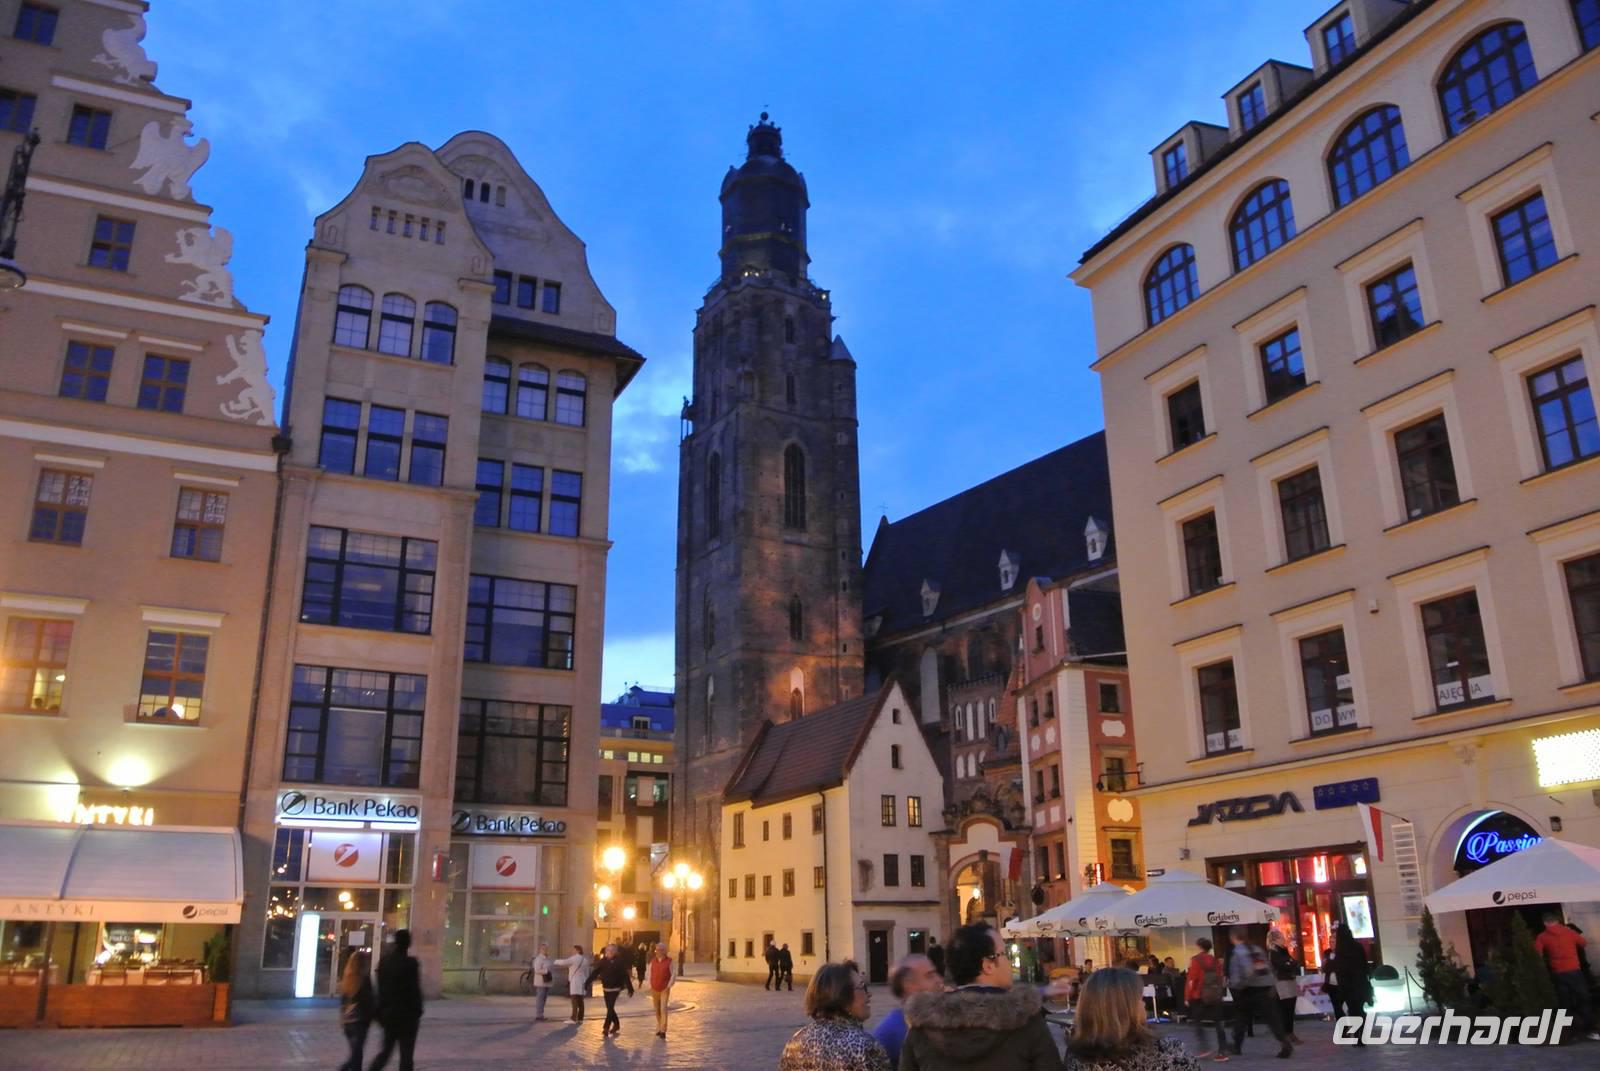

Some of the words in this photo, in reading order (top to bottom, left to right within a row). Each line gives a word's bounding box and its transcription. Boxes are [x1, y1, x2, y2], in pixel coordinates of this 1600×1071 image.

[313, 797, 360, 815] Bank
[363, 799, 419, 818] Pekao
[476, 814, 516, 832] Bank
[519, 816, 567, 833] Pekao
[1507, 889, 1537, 902] pepsi
[11, 903, 94, 916] ANTYKI
[1134, 913, 1168, 928] Carlsberg
[1207, 910, 1240, 926] Carlsberg
